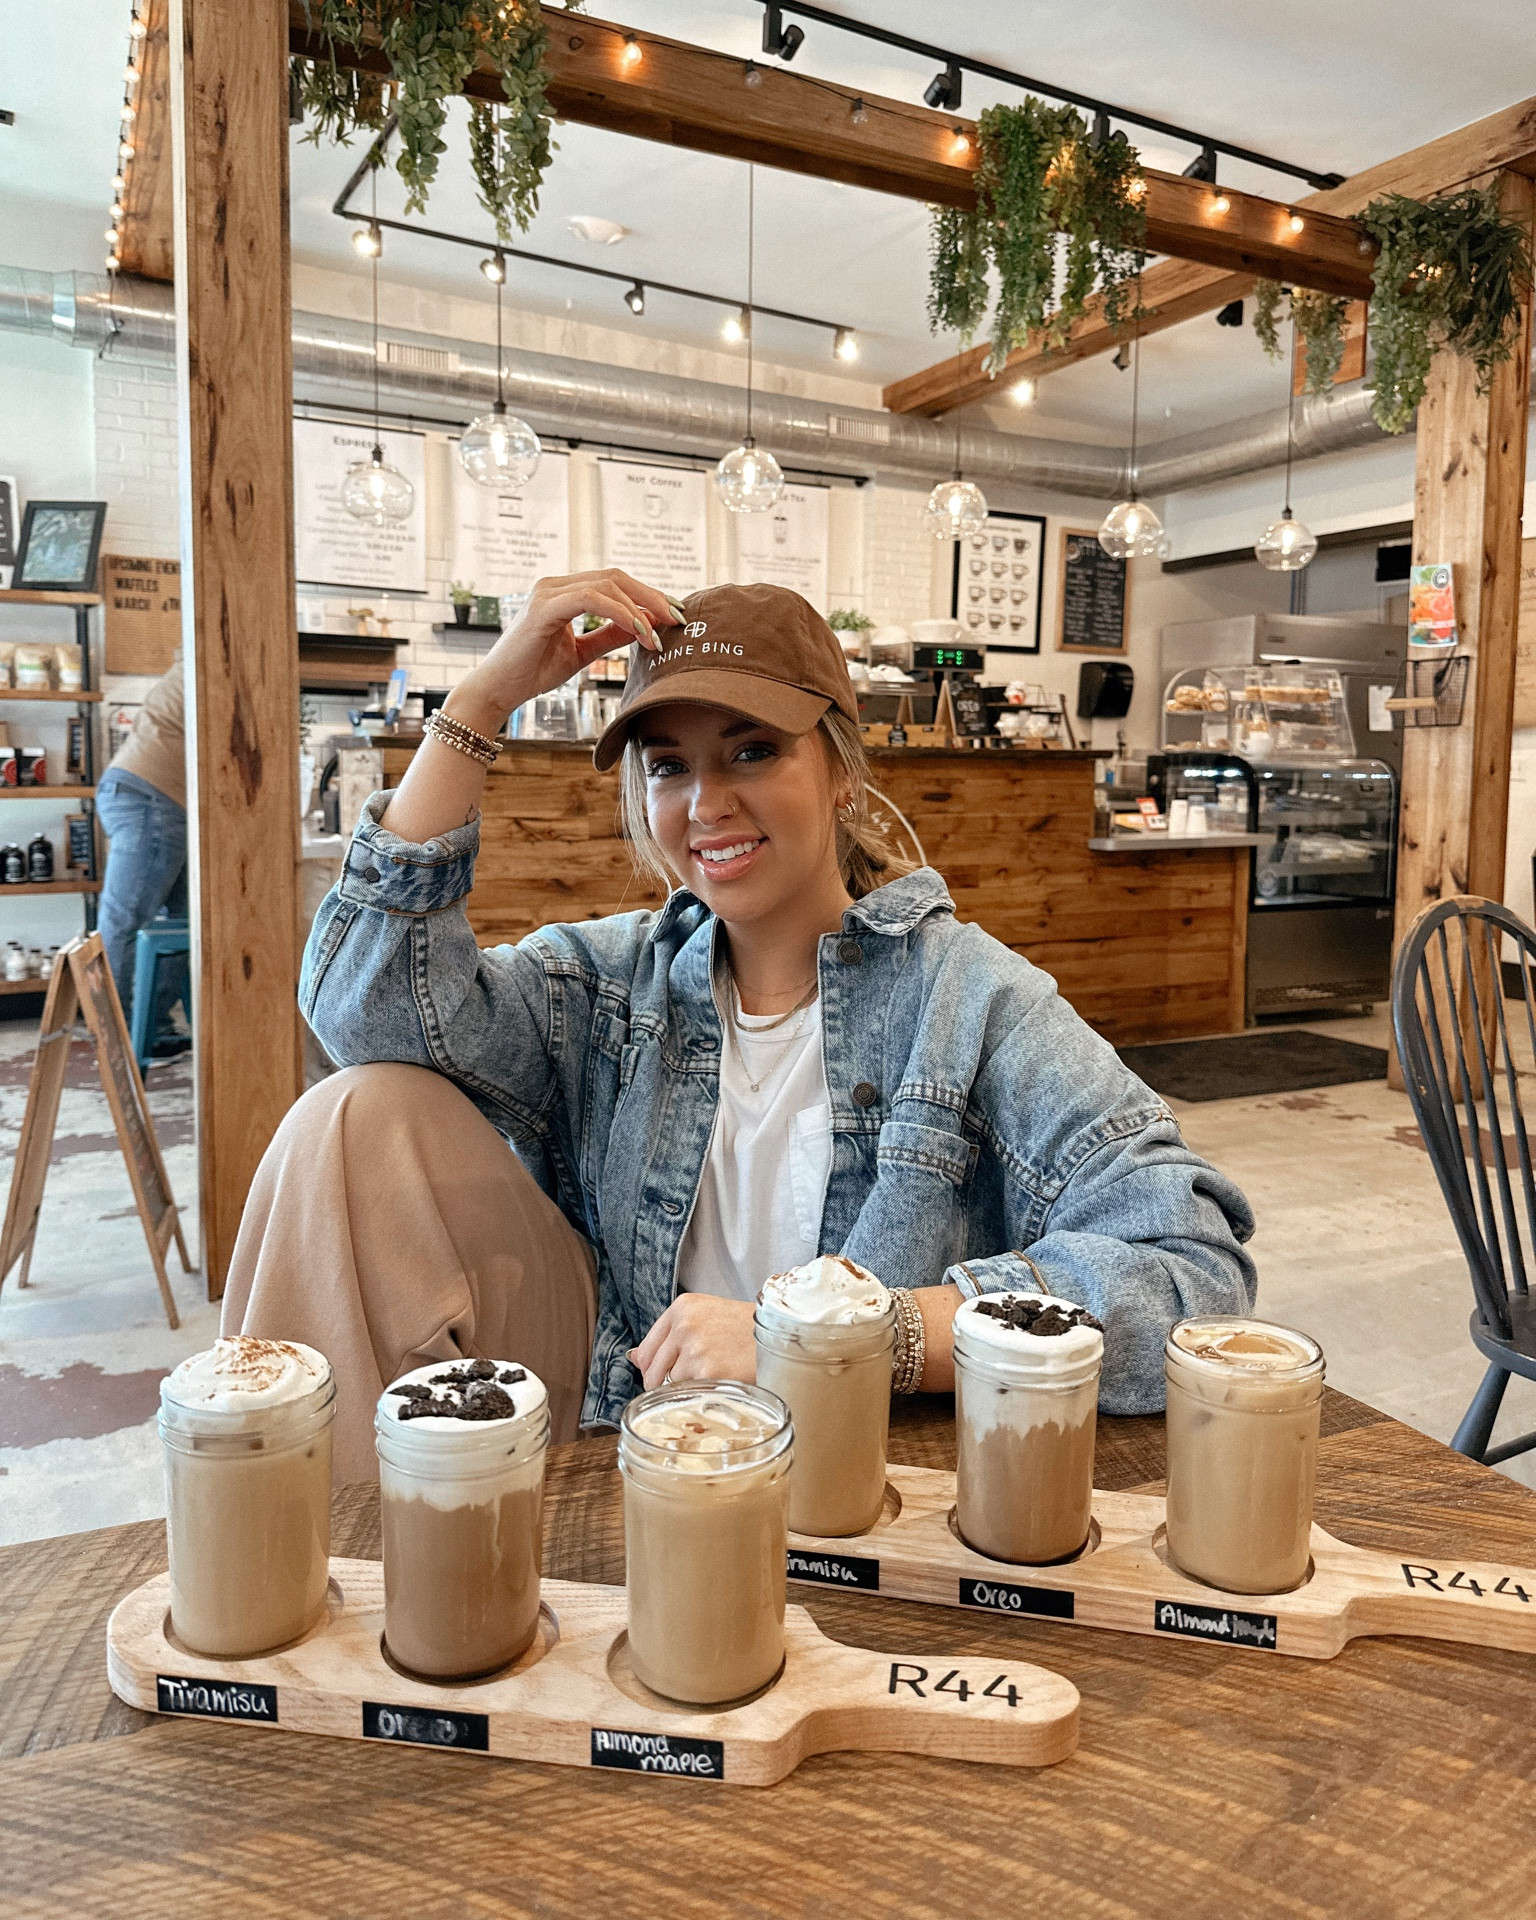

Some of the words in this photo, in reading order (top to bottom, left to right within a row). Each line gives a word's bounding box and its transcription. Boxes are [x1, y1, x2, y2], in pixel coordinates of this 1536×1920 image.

[333, 435, 387, 450] ESPRESO
[115, 577, 158, 593] WAFFLES
[648, 645, 694, 671] ANINE
[702, 642, 744, 656] BING
[972, 1582, 1022, 1610] Oreo
[1400, 1563, 1533, 1602] R44
[1160, 1604, 1231, 1635] Almond
[158, 1678, 270, 1715] Tiramisu
[888, 1662, 1024, 1708] R44
[593, 1730, 670, 1755] Almond
